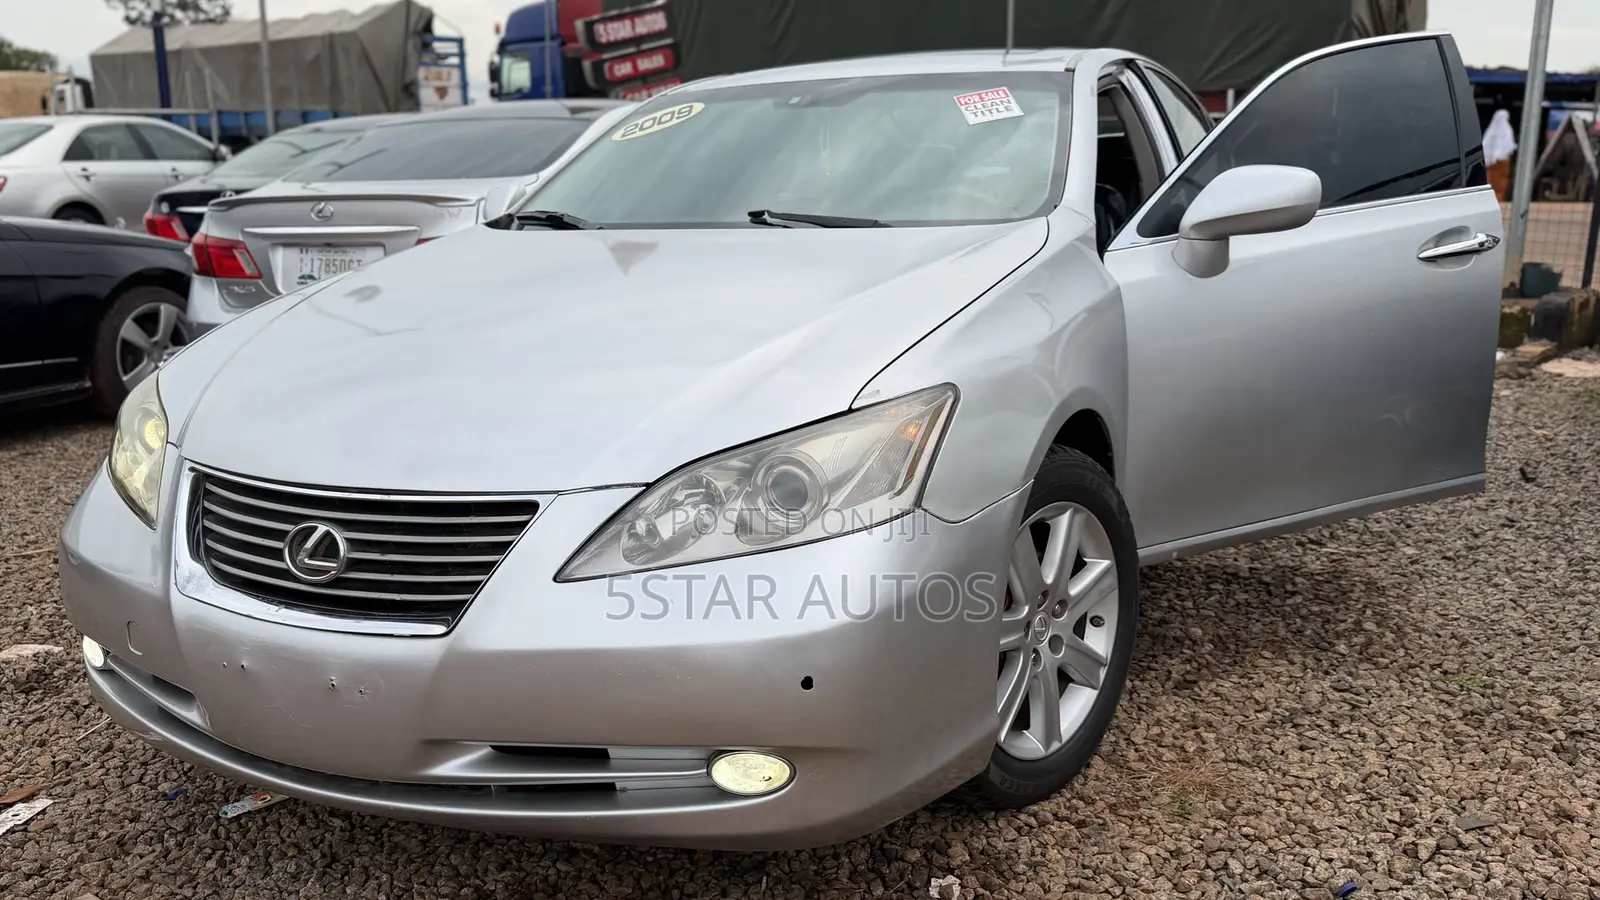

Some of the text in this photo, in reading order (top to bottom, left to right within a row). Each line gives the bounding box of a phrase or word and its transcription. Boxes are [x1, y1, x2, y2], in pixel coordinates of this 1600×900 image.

[634, 10, 667, 36] AUTOS
[613, 53, 665, 77] CAR SALES
[959, 89, 1007, 106] FOR SALE
[965, 99, 1012, 112] CLEAN
[620, 104, 694, 138] 2009
[970, 105, 1014, 117] TITLE
